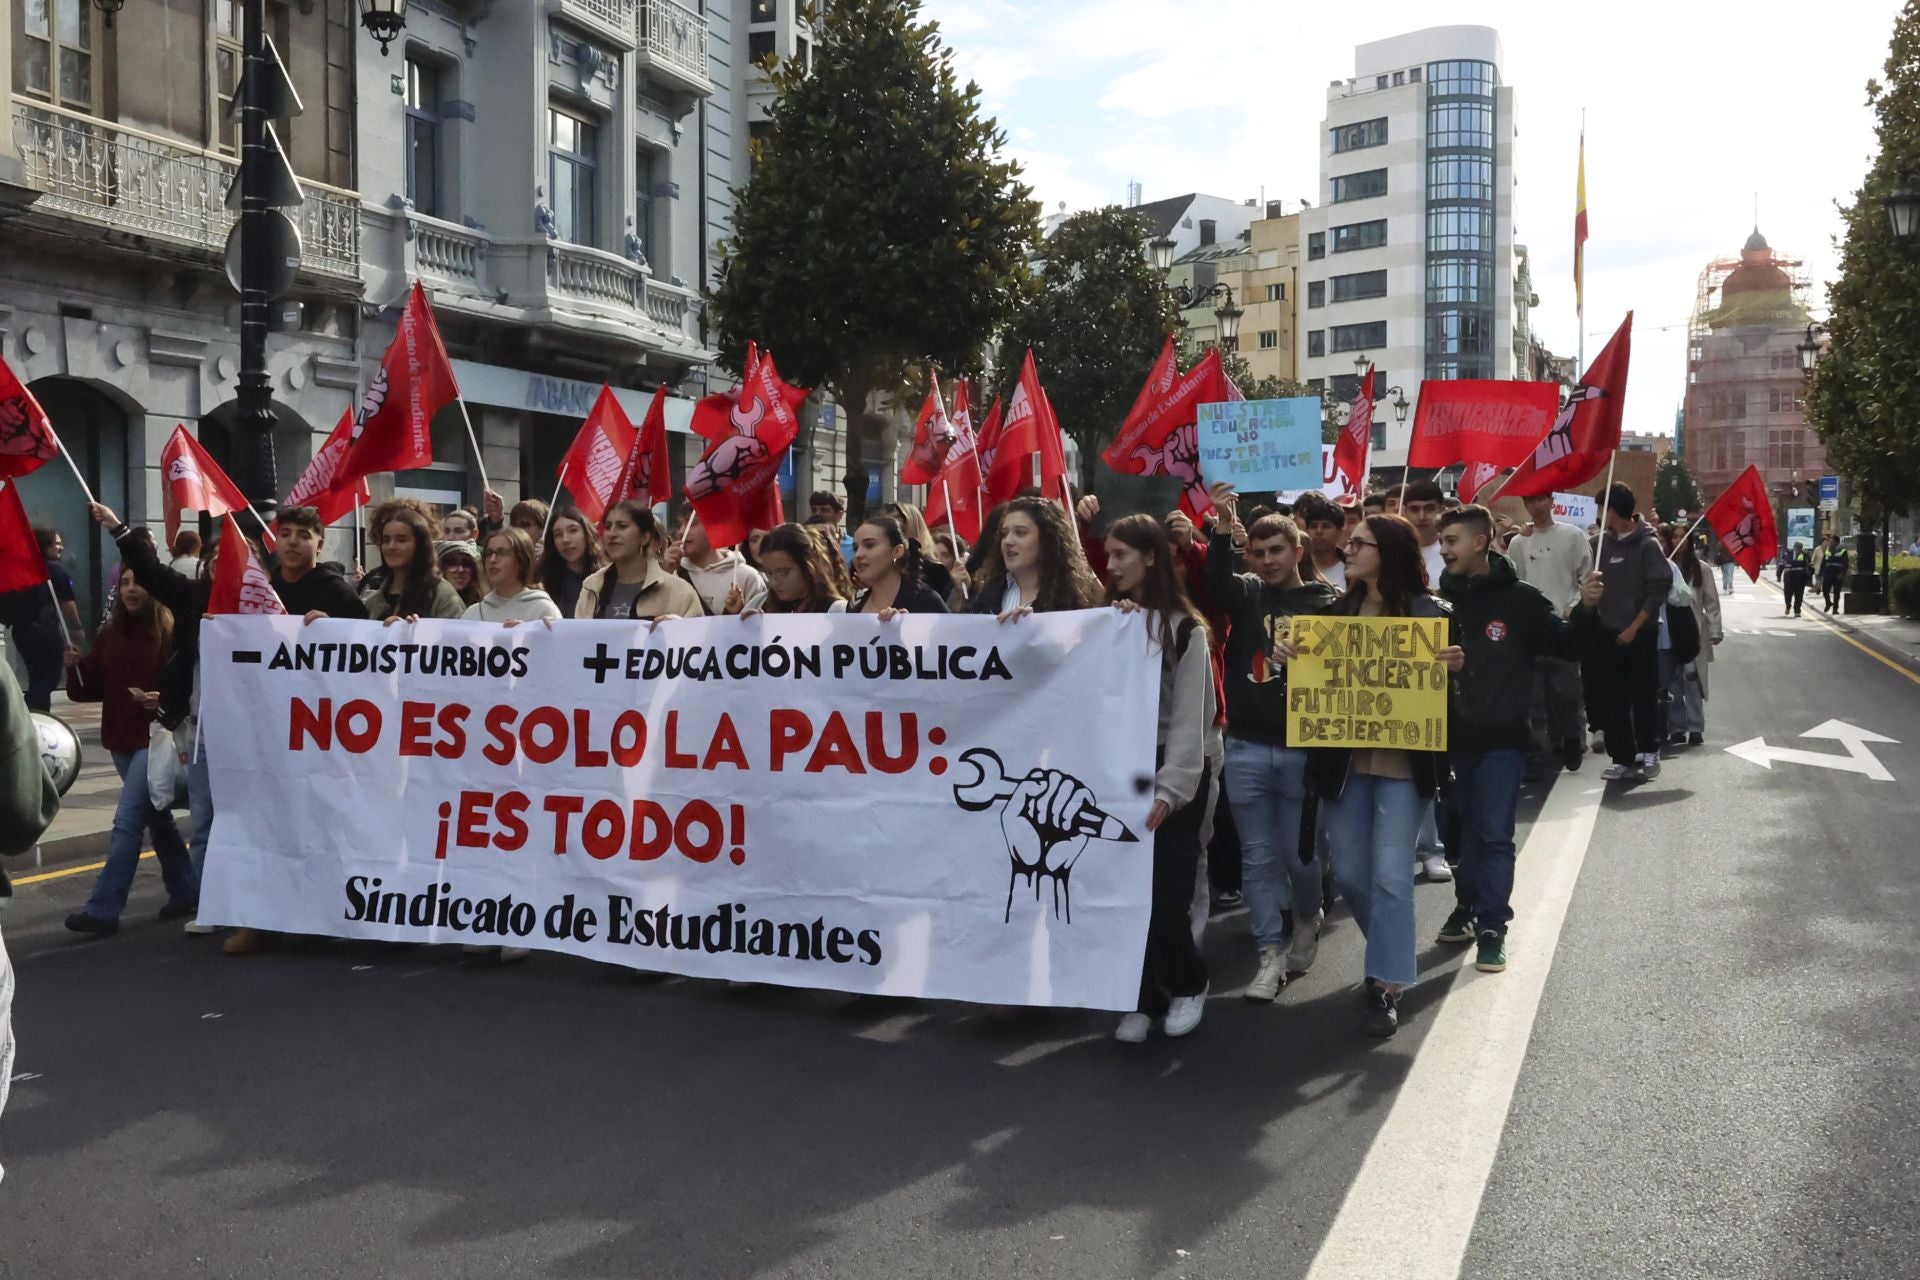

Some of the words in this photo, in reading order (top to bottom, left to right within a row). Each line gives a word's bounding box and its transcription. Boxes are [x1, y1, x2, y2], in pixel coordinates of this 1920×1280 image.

[533, 376, 597, 414] ABANC
[759, 365, 788, 425] Sindicato
[1237, 431, 1258, 443] NO
[268, 642, 530, 678] ANTIDISTURBIOS
[625, 636, 820, 682] EDUCACIÓN
[832, 636, 1013, 681] PÚBLICA
[1294, 620, 1442, 659] EXAMEN
[1324, 656, 1445, 691] INCIERTO
[1291, 687, 1392, 716] FUTURO
[289, 697, 382, 753] NO
[400, 701, 471, 759] ES
[483, 706, 648, 768] SOLO
[665, 710, 749, 770] LA
[770, 709, 947, 775] PAU:
[435, 791, 531, 859] ¡ES
[543, 795, 746, 866] TODO!
[344, 876, 536, 937] Sindicato
[544, 895, 597, 942] de
[607, 895, 881, 967] Estudiantes
